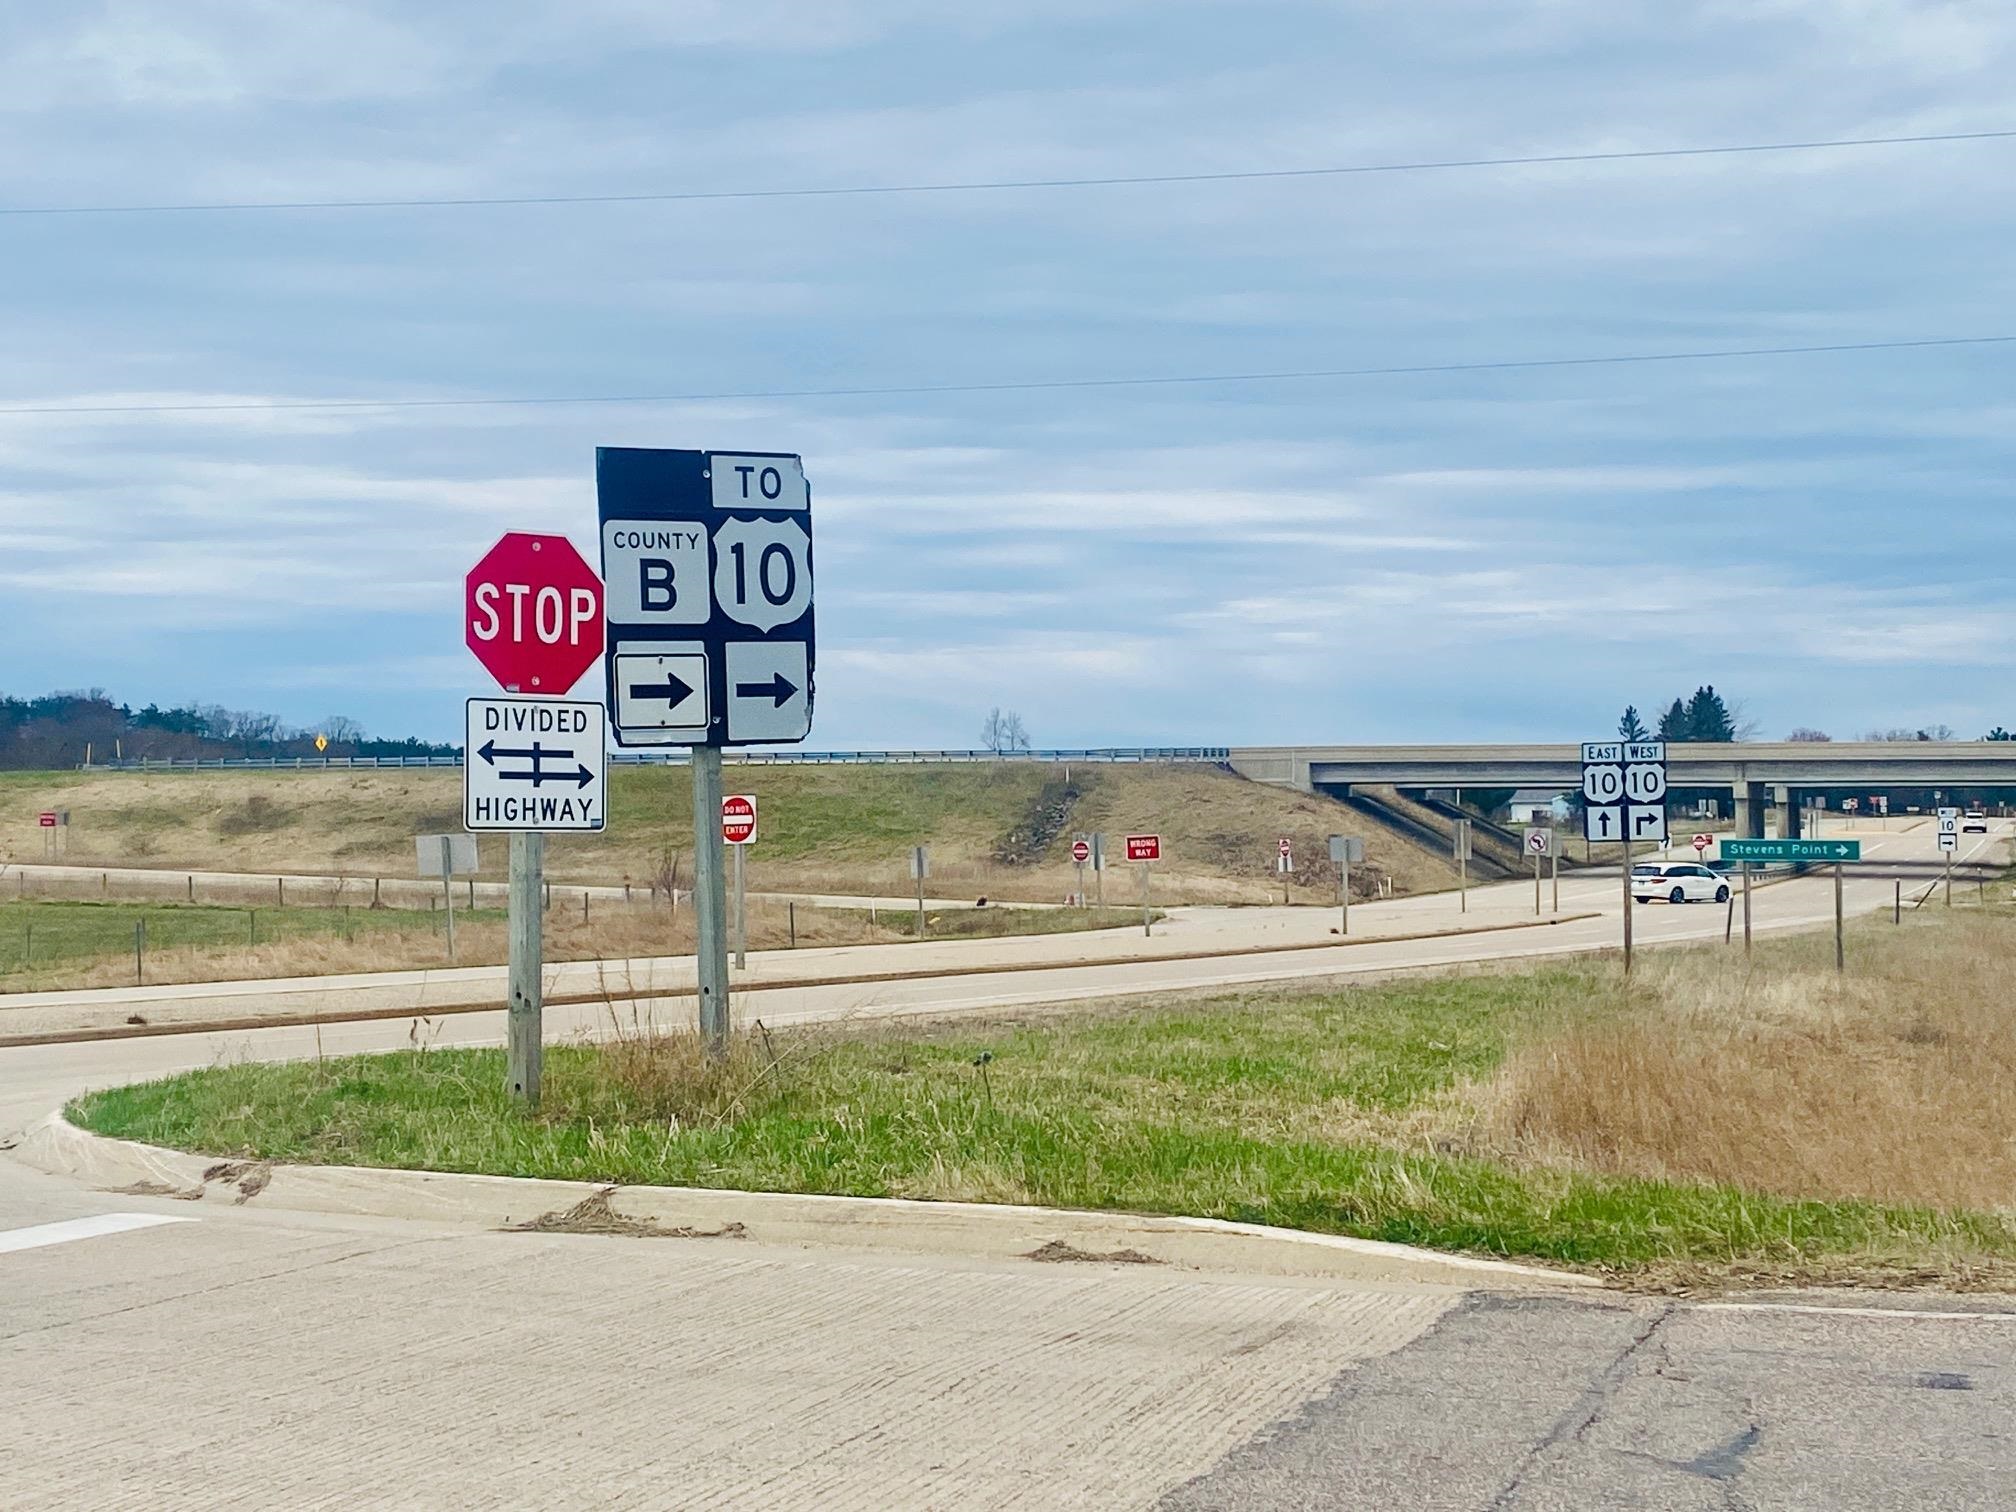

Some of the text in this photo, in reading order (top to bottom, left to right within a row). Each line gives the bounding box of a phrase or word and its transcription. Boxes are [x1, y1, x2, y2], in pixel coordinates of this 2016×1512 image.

[734, 465, 781, 500] TO
[613, 531, 700, 550] COUNTY
[730, 541, 796, 606] 10
[639, 558, 677, 612] B
[473, 582, 596, 645] STOP
[486, 707, 587, 733] DIVIDED
[1588, 746, 1617, 760] EAST
[1629, 745, 1658, 759] WEST
[1590, 772, 1616, 795] 10
[1631, 771, 1658, 794] 10
[476, 797, 593, 822] HIGHWAY
[724, 805, 749, 814] DO NOT
[725, 825, 748, 834] ENTER
[1941, 820, 1954, 831] 10
[1130, 839, 1156, 847] WRONG
[1730, 844, 1828, 855] Stevens Point
